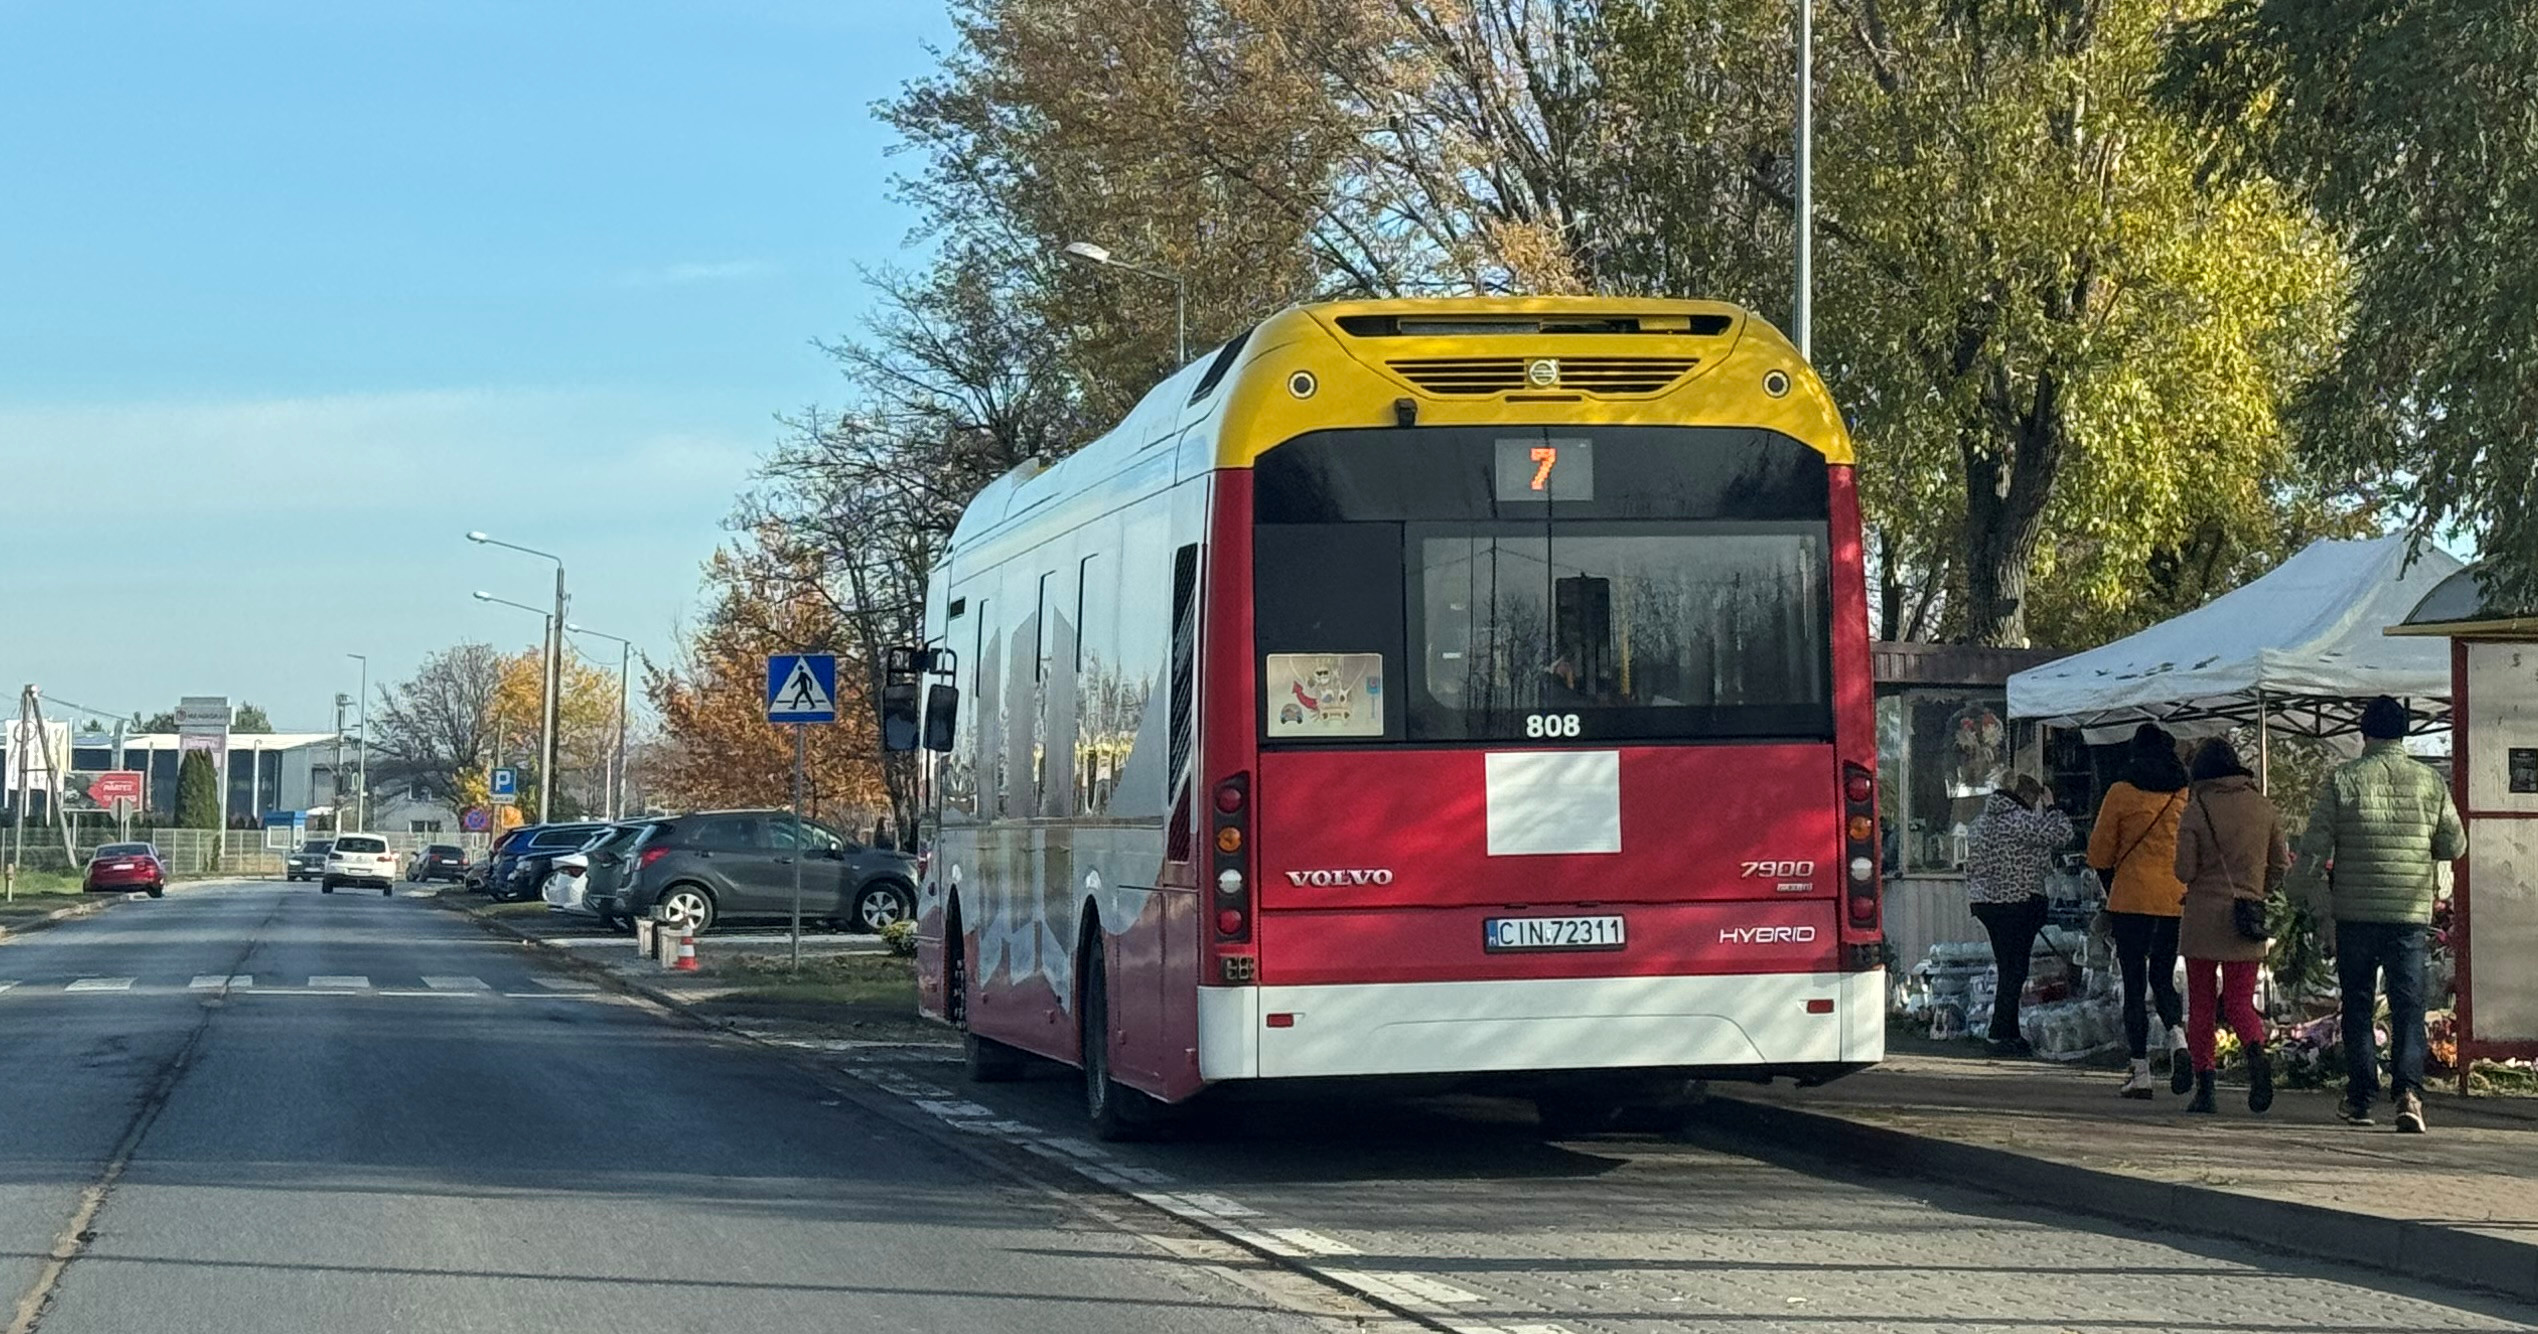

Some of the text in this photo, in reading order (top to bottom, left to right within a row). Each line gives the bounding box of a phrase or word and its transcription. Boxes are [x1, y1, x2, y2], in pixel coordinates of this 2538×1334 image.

[1530, 447, 1557, 491] 7
[1526, 714, 1580, 738] 808
[495, 770, 511, 791] P
[1284, 869, 1393, 886] VOLVO
[1740, 861, 1814, 878] 7900
[1499, 919, 1619, 945] CIN 72311
[1719, 926, 1816, 943] HYBRID
